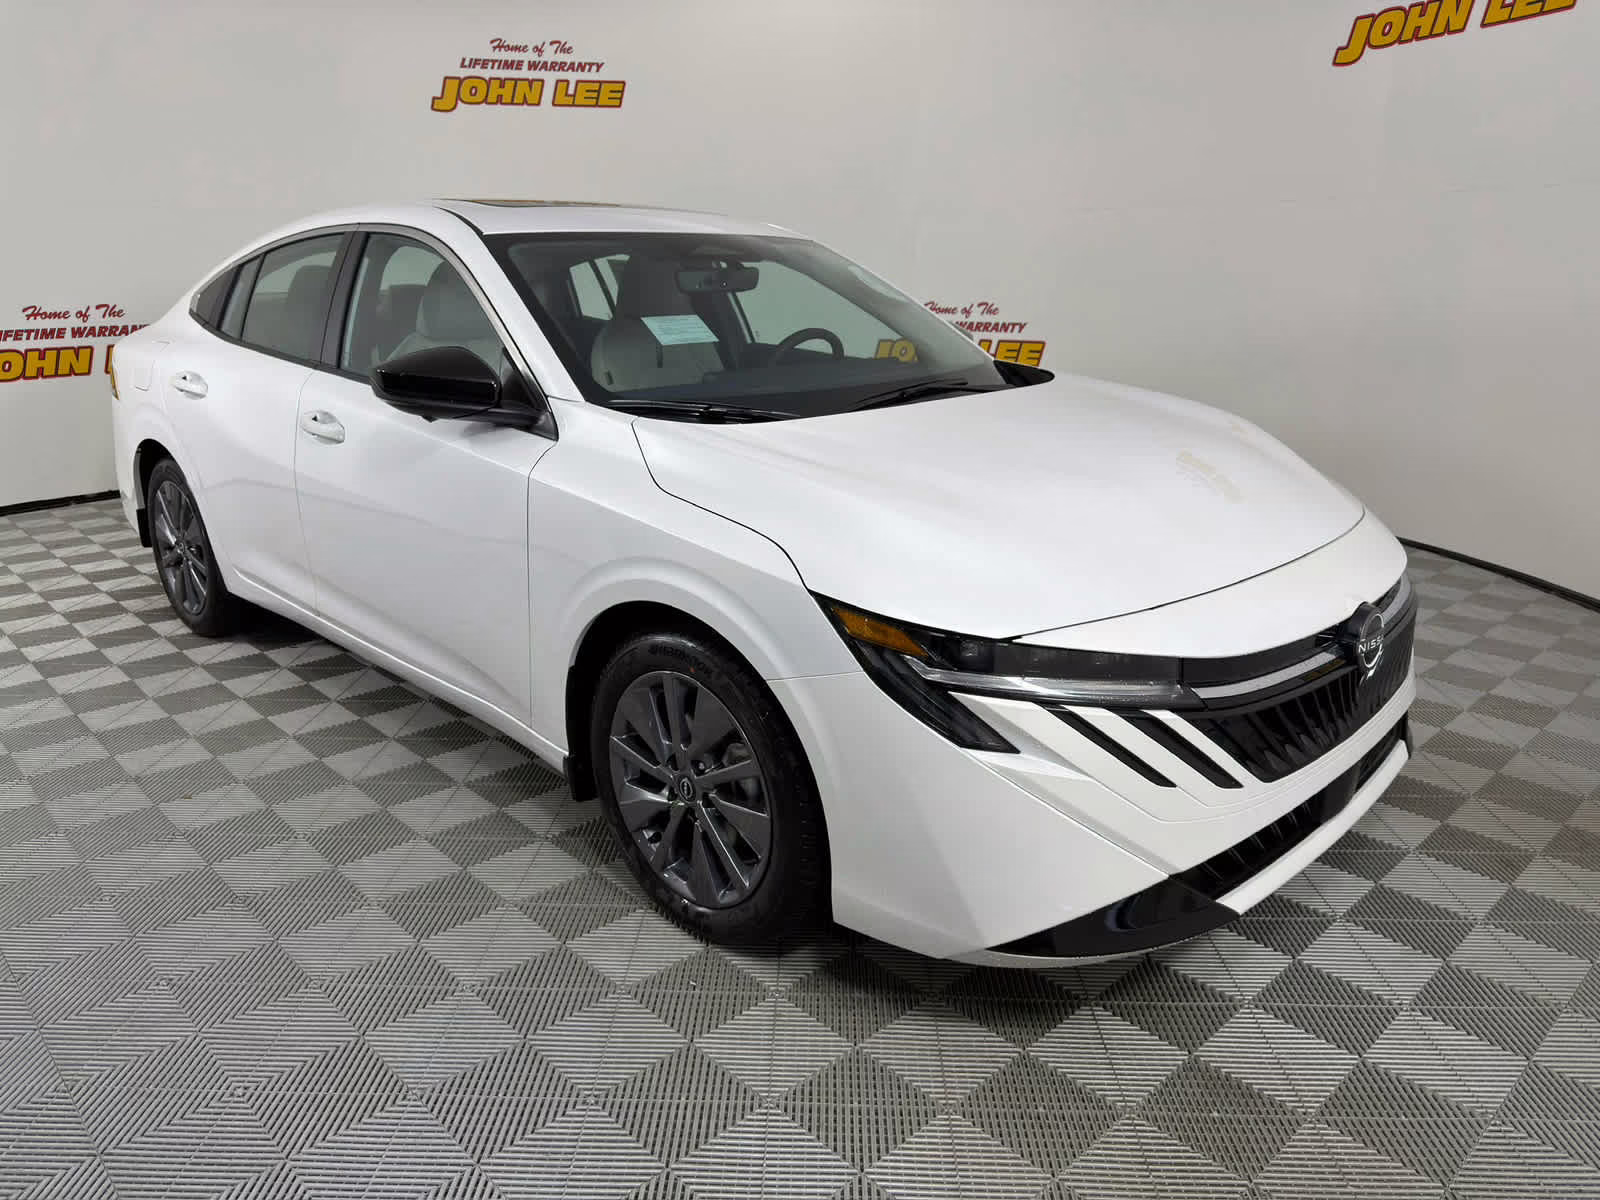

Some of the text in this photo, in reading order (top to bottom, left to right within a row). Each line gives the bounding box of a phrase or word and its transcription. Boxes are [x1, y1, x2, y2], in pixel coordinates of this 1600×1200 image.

[1332, 0, 1475, 66] JOHN
[490, 38, 574, 57] Home of The
[460, 57, 604, 73] LIFETIME WARRANTY
[431, 76, 626, 112] JOHN LEE
[22, 303, 125, 323] Home of The
[961, 303, 974, 318] of
[977, 301, 1000, 316] The
[0, 327, 66, 341] IFETIME
[0, 346, 94, 382] OHN
